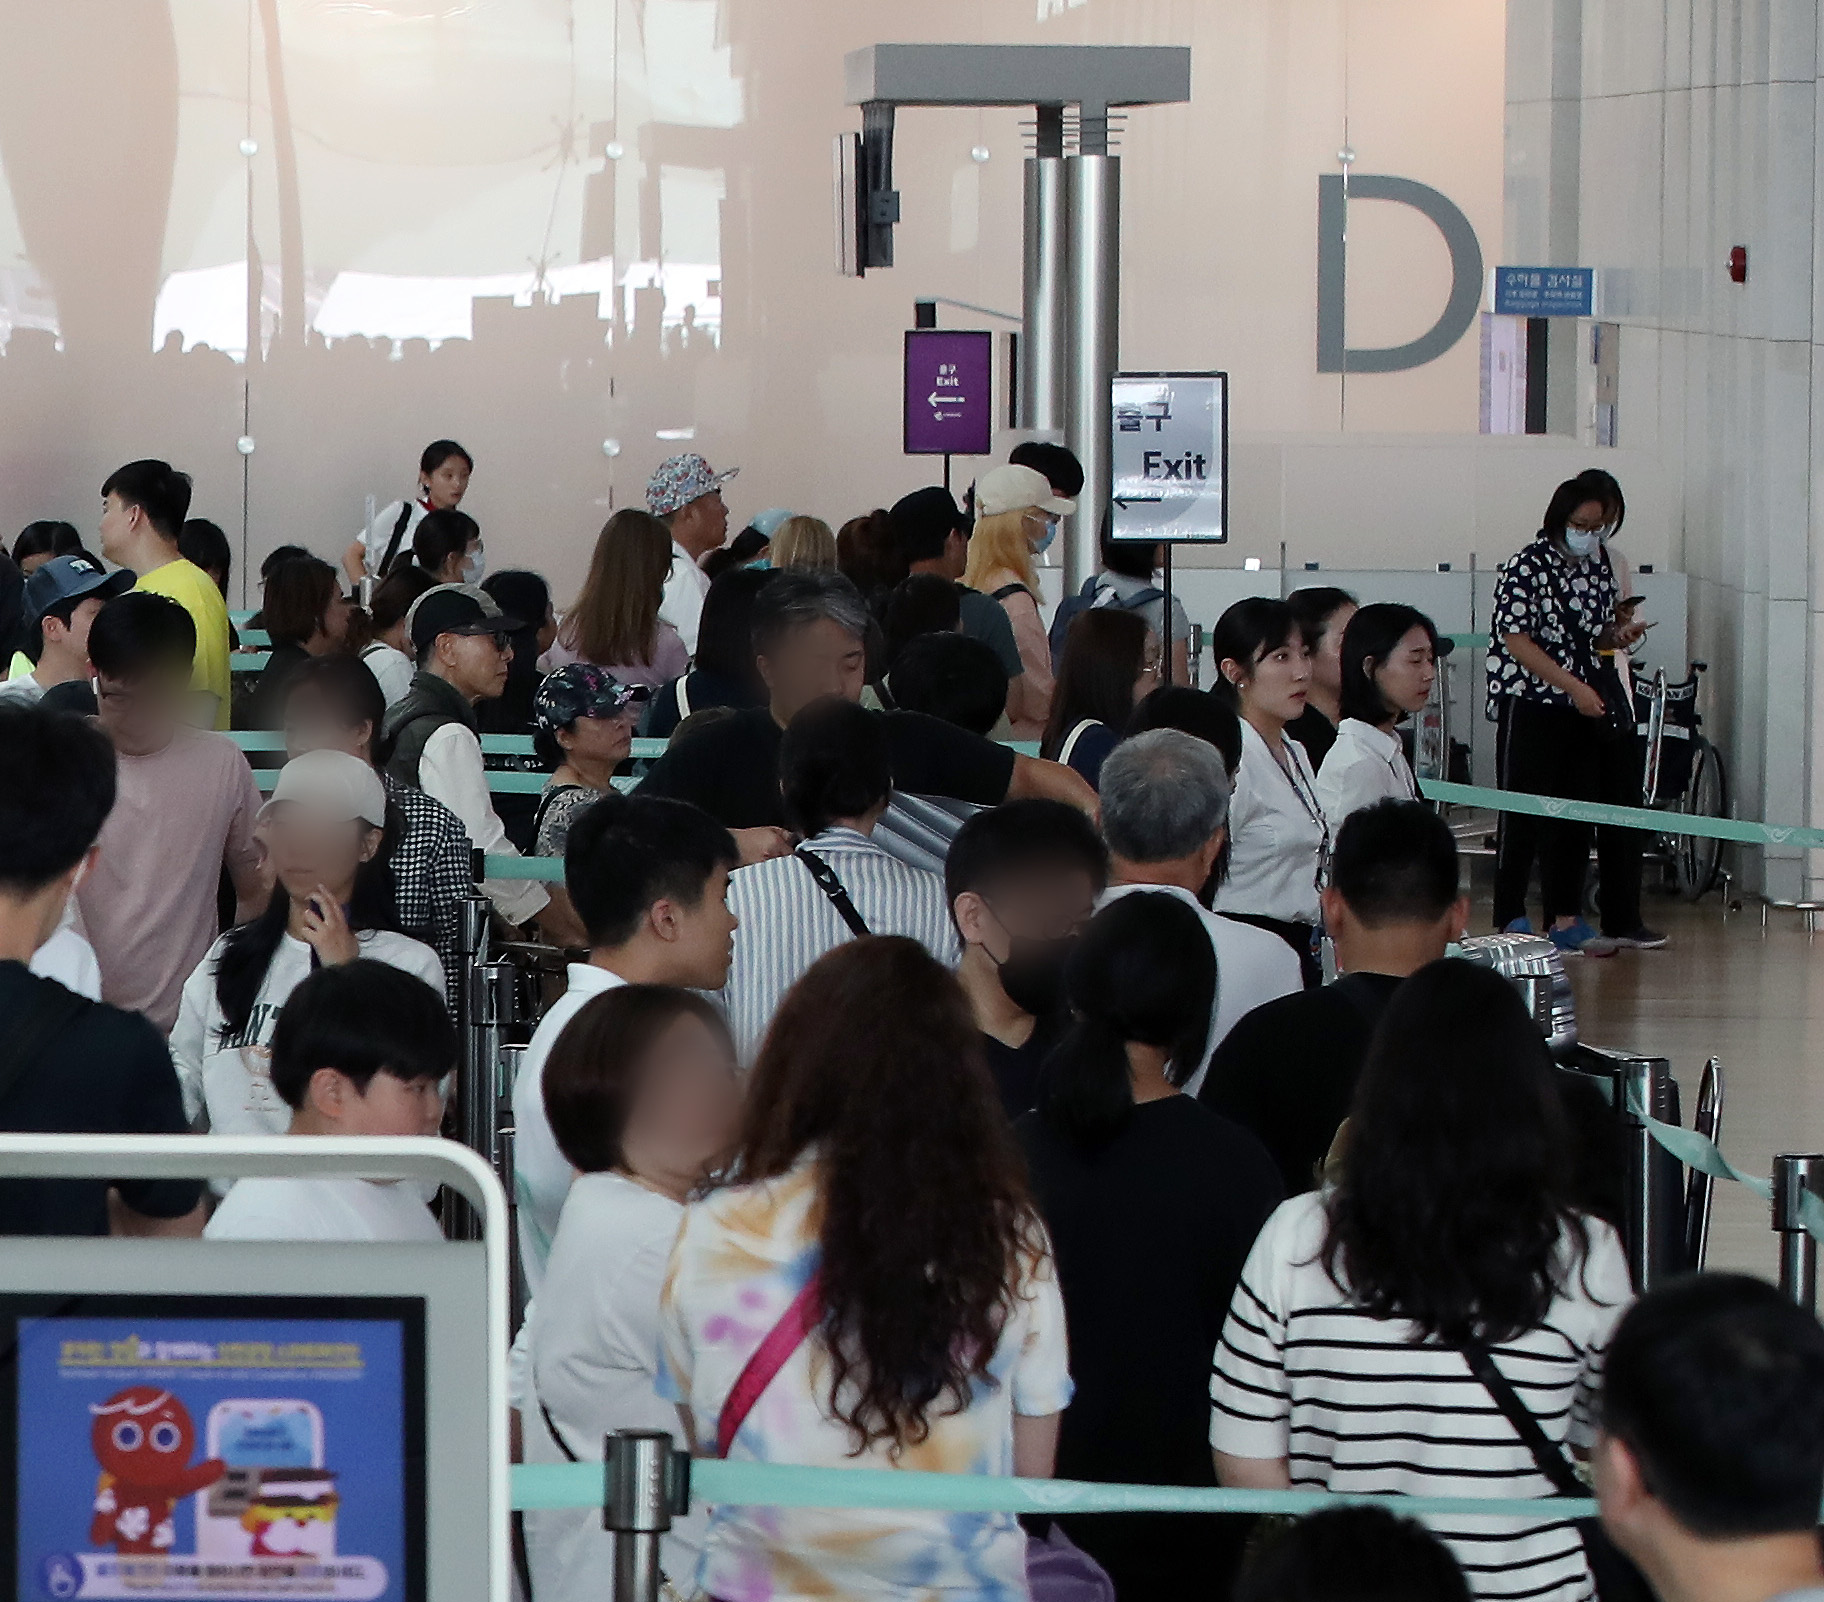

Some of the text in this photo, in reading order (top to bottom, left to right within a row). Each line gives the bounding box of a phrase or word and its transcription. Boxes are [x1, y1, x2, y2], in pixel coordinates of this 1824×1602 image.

[1316, 174, 1484, 374] D
[935, 376, 960, 387] Exit
[1143, 451, 1207, 481] Exit
